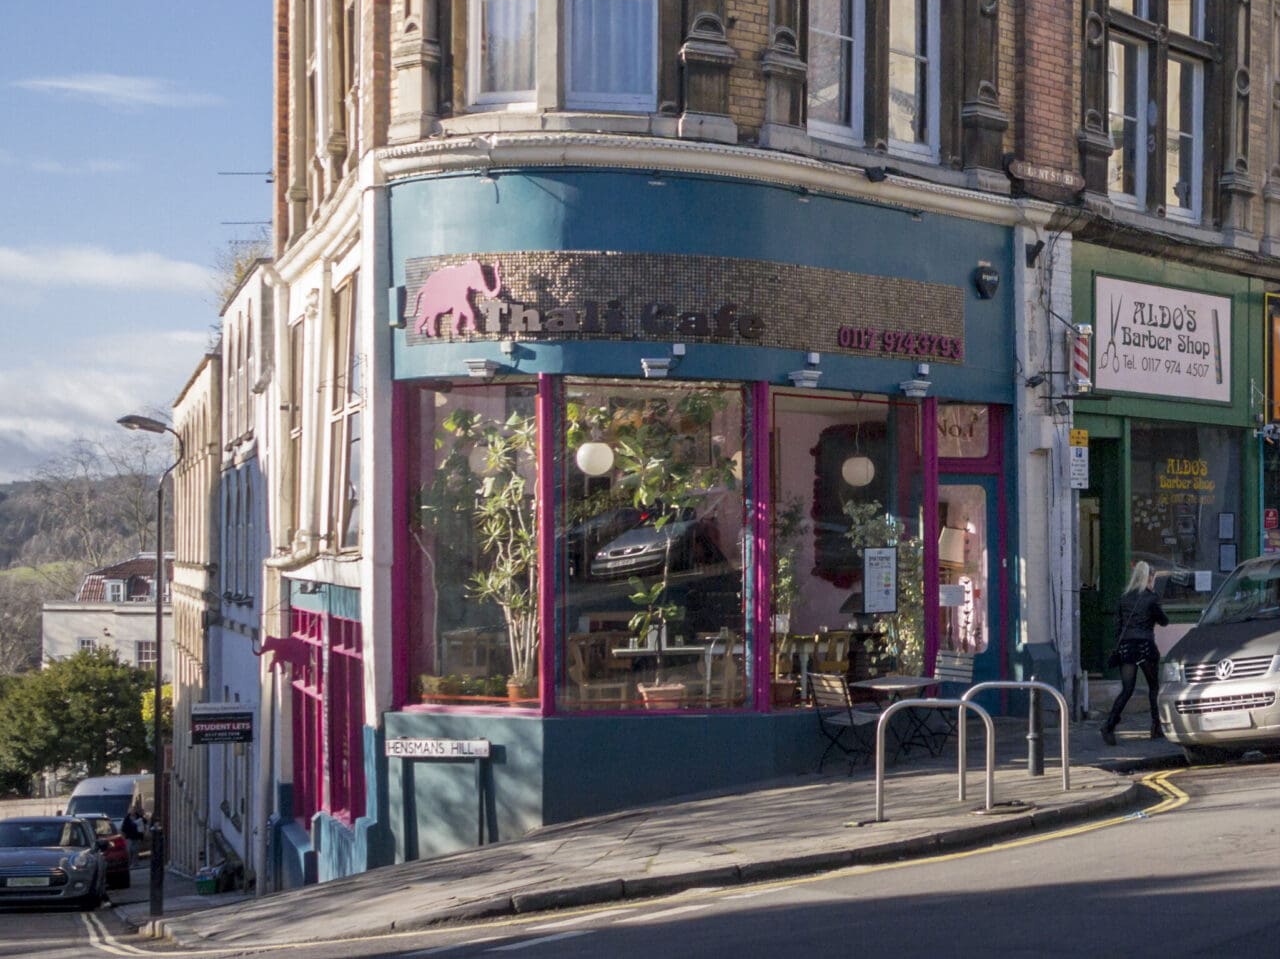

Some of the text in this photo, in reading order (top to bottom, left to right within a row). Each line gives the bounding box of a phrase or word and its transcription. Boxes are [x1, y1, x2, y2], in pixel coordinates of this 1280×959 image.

[481, 300, 765, 338] Thali Cafe
[1133, 301, 1197, 332] ALDO'S
[839, 326, 876, 350] 0117
[1121, 326, 1210, 360] Barber Shop
[1141, 356, 1162, 373] 0117
[1164, 359, 1182, 375] 974
[1185, 363, 1210, 378] 4507
[194, 722, 251, 732] STUDENT LETS
[387, 741, 446, 754] HENSMANS
[451, 741, 474, 755] HILL
